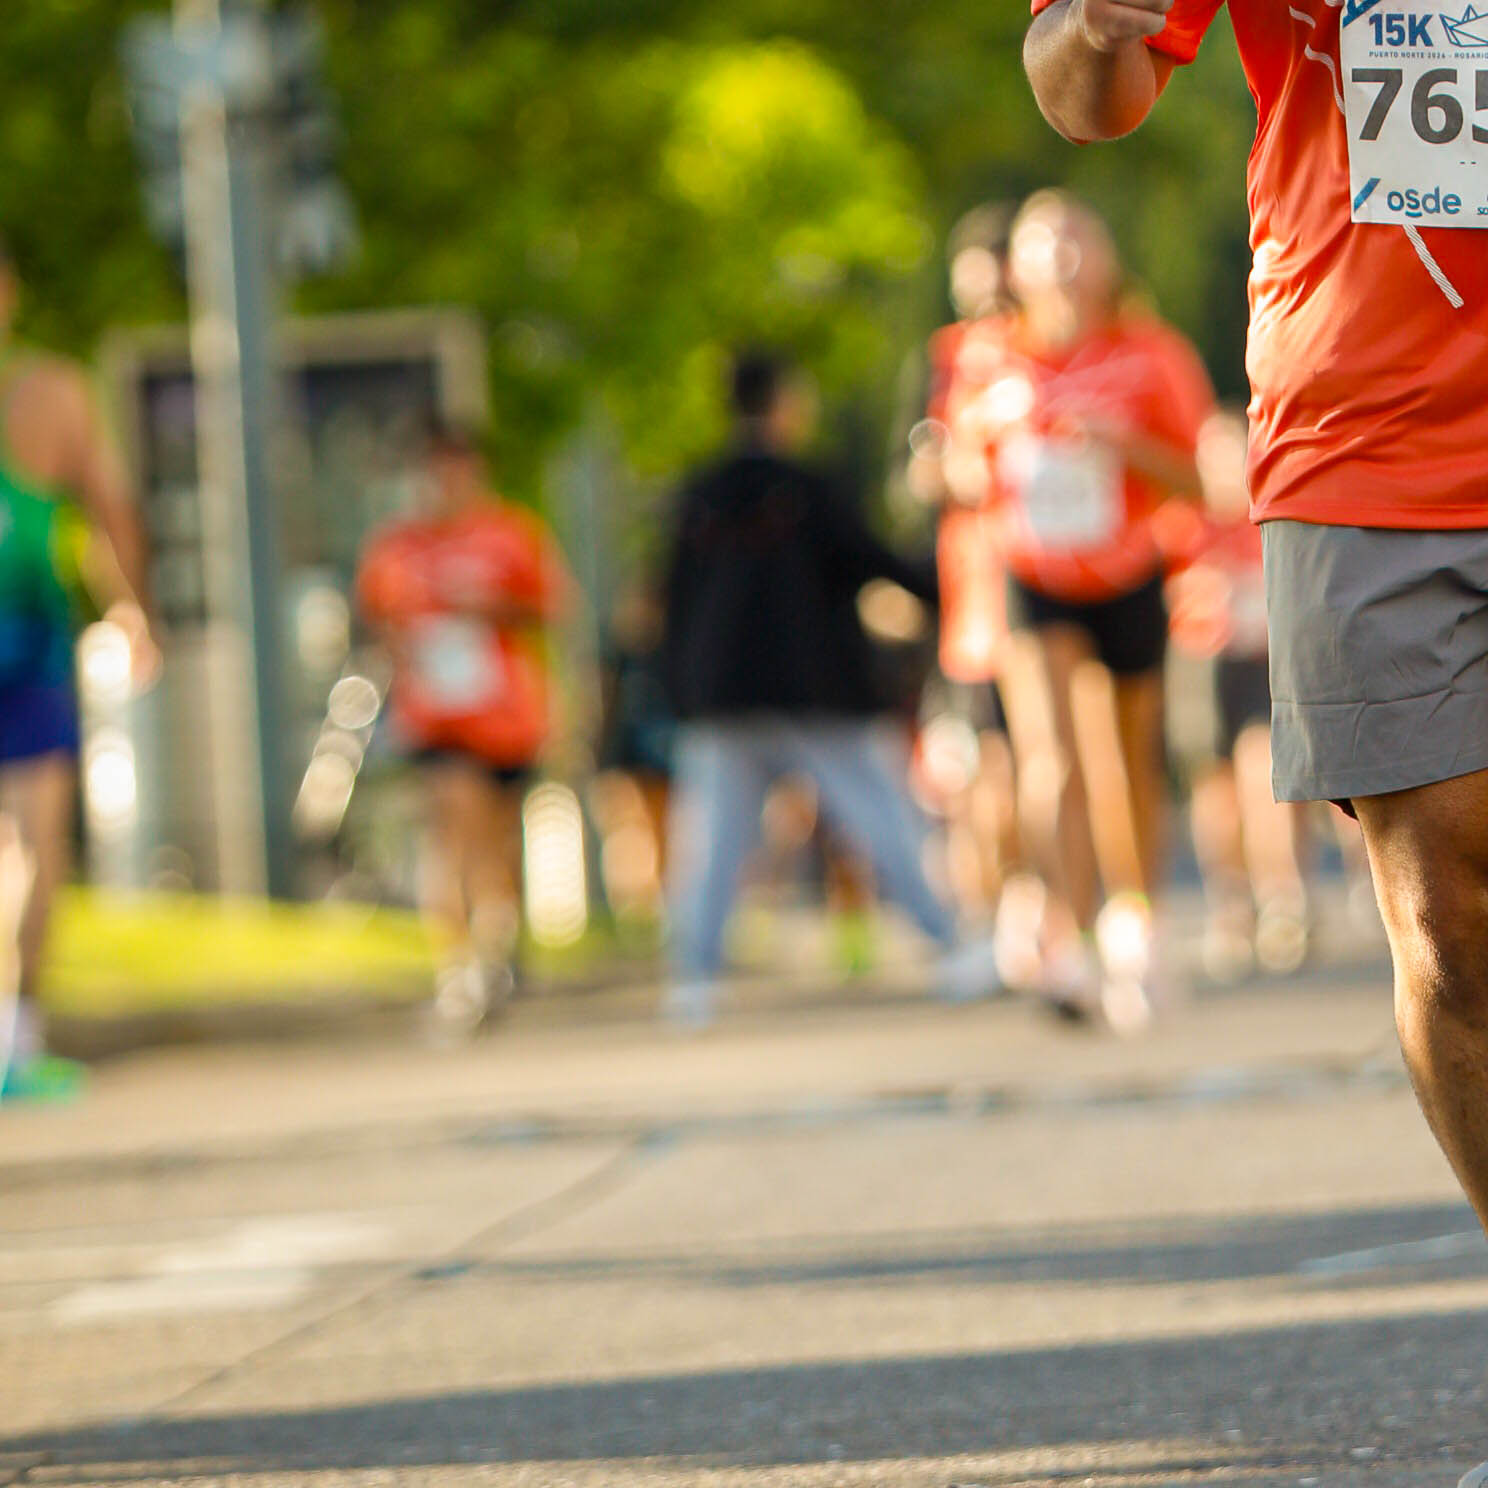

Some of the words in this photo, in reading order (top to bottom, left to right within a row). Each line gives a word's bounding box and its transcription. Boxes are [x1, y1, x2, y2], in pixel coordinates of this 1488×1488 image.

[1368, 13, 1434, 47] 15K
[1368, 51, 1399, 59] PUERTO
[1400, 51, 1425, 59] NORTE
[1387, 185, 1462, 218] osde
